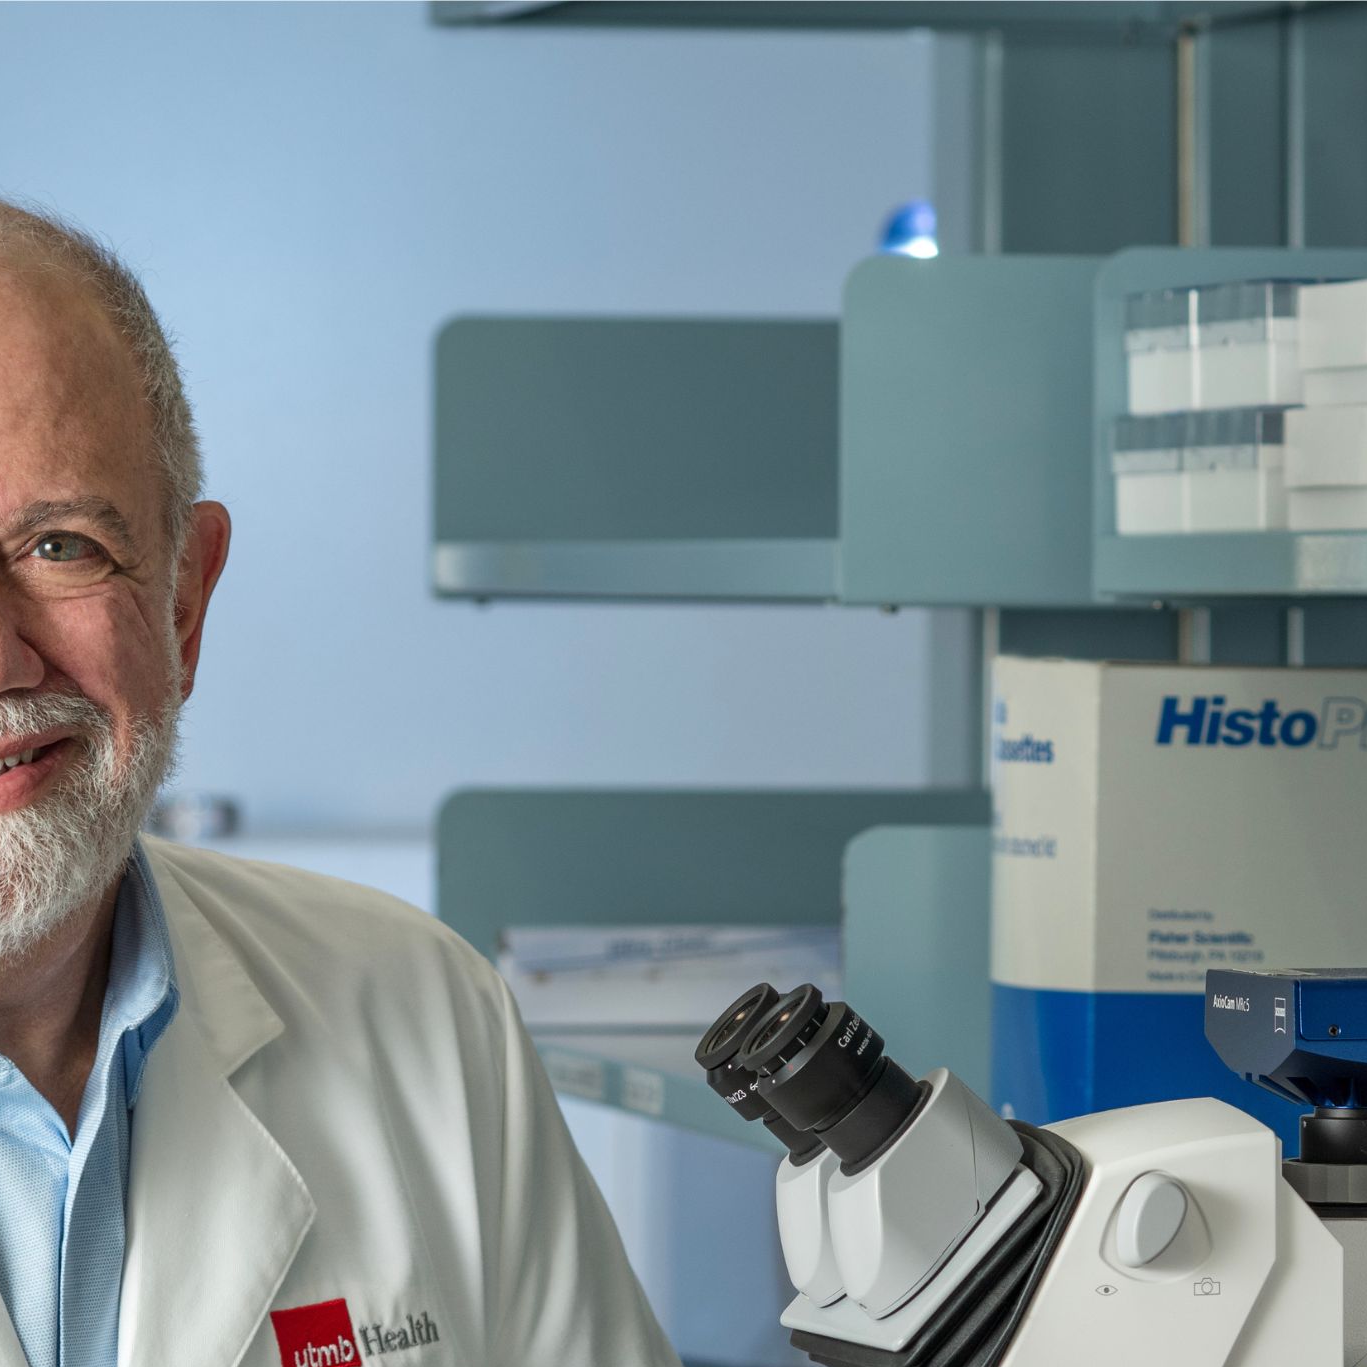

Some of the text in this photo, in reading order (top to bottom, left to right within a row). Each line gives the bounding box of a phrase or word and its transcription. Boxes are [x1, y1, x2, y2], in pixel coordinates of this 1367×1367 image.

[1213, 994, 1235, 1010] AxioCam
[838, 1026, 855, 1048] Carl
[358, 1311, 440, 1358] Health
